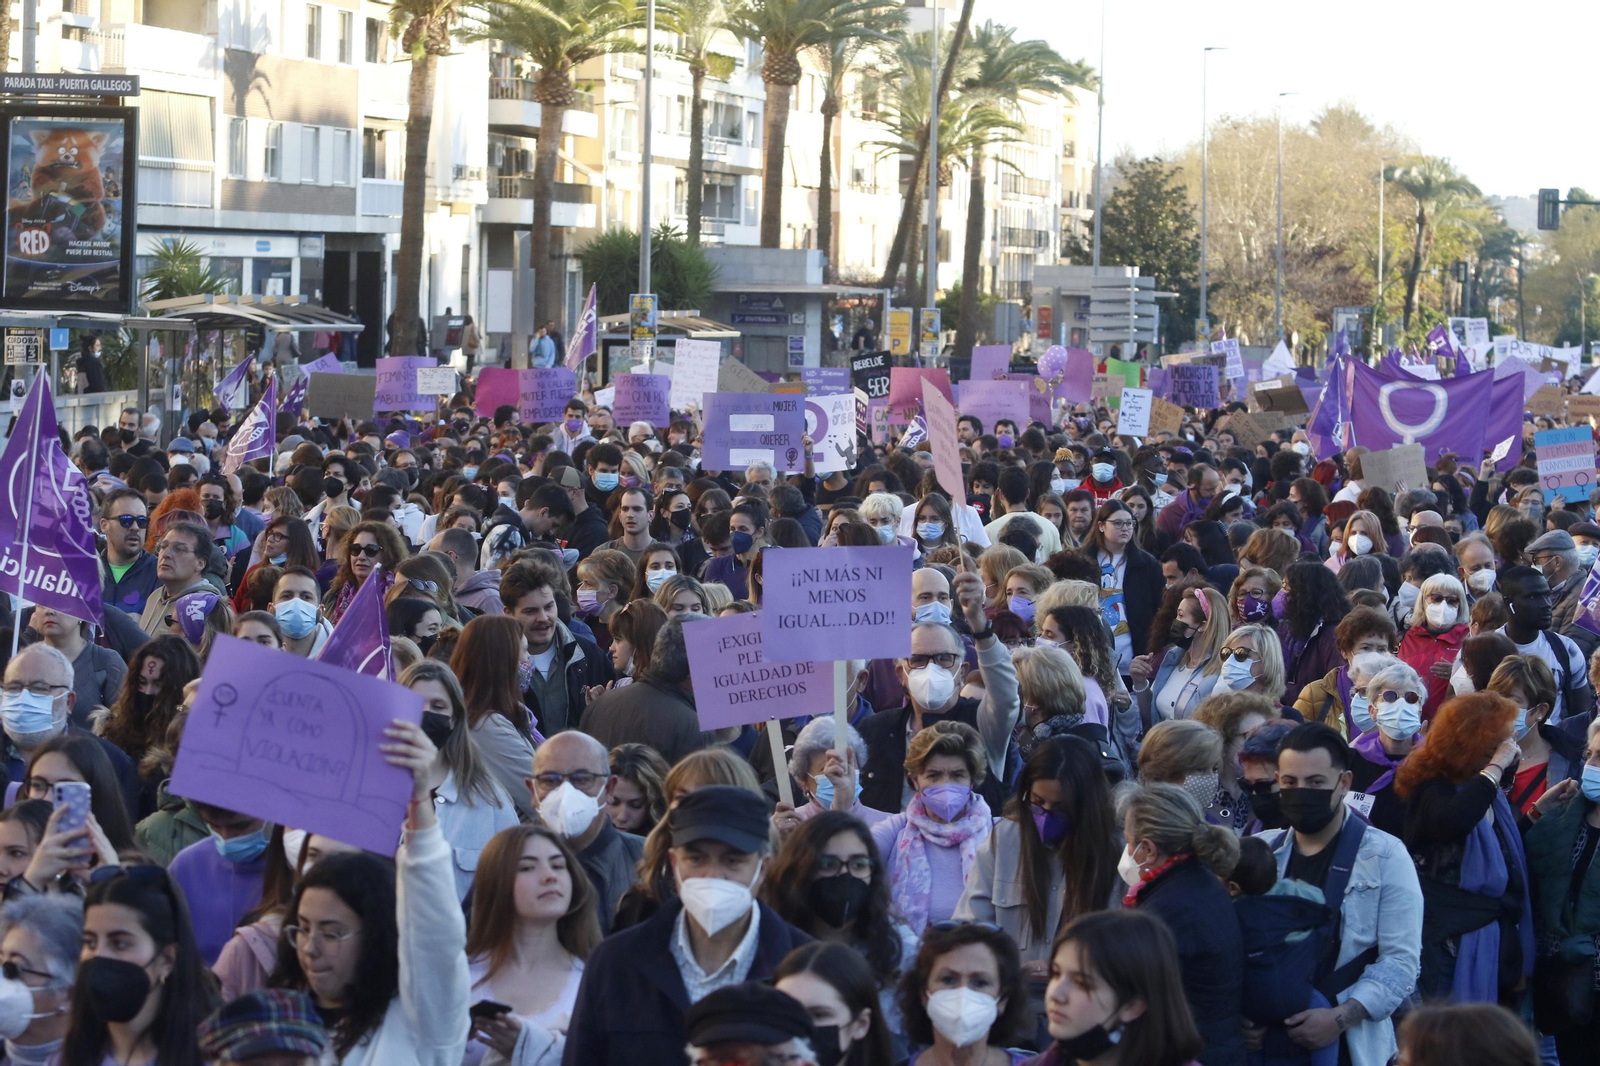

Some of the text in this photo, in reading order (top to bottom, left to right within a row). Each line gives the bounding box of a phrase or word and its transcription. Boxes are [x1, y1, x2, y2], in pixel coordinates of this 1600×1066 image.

[5, 77, 36, 89] PARADA
[37, 78, 54, 89] TAXI
[60, 79, 90, 90] PUERTA
[91, 80, 132, 92] GALLEGOS
[19, 229, 50, 255] RED
[892, 338, 901, 350] P
[1510, 341, 1533, 356] POR
[1538, 345, 1554, 358] UN
[853, 356, 884, 371] REBELDE
[868, 377, 890, 397] SER
[1173, 381, 1214, 394] FUERA DE
[773, 400, 798, 412] MUJER
[1172, 394, 1215, 408] MI VISTA!
[760, 433, 790, 446] QUERER
[1546, 431, 1576, 445] POR UN
[1545, 443, 1587, 458] FEMINISMO
[791, 564, 883, 587] ¡¡NI MÁS NI
[808, 588, 866, 604] MENOS
[778, 611, 895, 629] IGUAL...DAD!!
[717, 631, 762, 653] ¡EXIGI
[737, 650, 762, 666] PLE
[713, 661, 815, 689] IGUALDAD DE
[728, 681, 807, 705] DERECHOS
[286, 716, 324, 739] COMO
